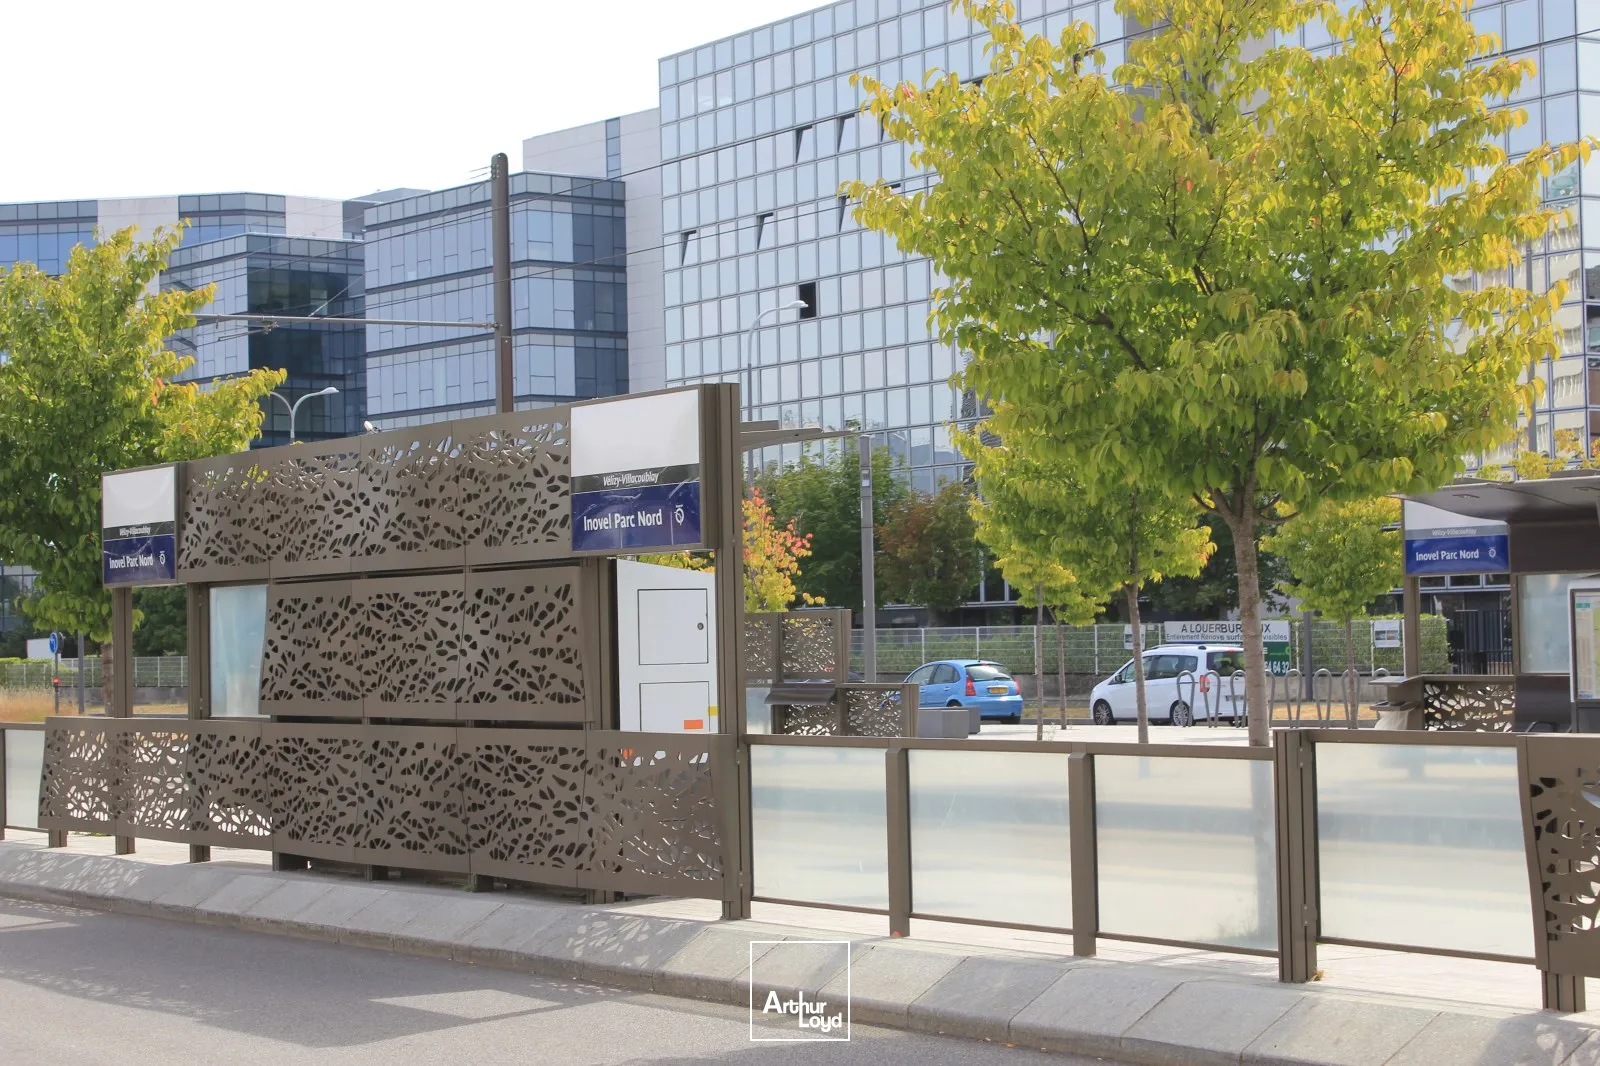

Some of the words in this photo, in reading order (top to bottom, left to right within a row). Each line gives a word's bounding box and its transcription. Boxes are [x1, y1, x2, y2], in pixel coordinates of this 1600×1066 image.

[603, 471, 659, 487] Vélizy-Villacoublay
[583, 512, 612, 531] Inovel
[614, 513, 636, 529] Parc
[637, 508, 663, 527] Nord
[109, 555, 126, 569] Inovel
[126, 555, 139, 568] Parc
[139, 553, 154, 567] Nord
[1415, 549, 1439, 561] Inovel
[1440, 550, 1458, 560] Parc
[1459, 548, 1480, 559] Nord
[1181, 623, 1188, 633] A
[1220, 623, 1271, 633] BURX
